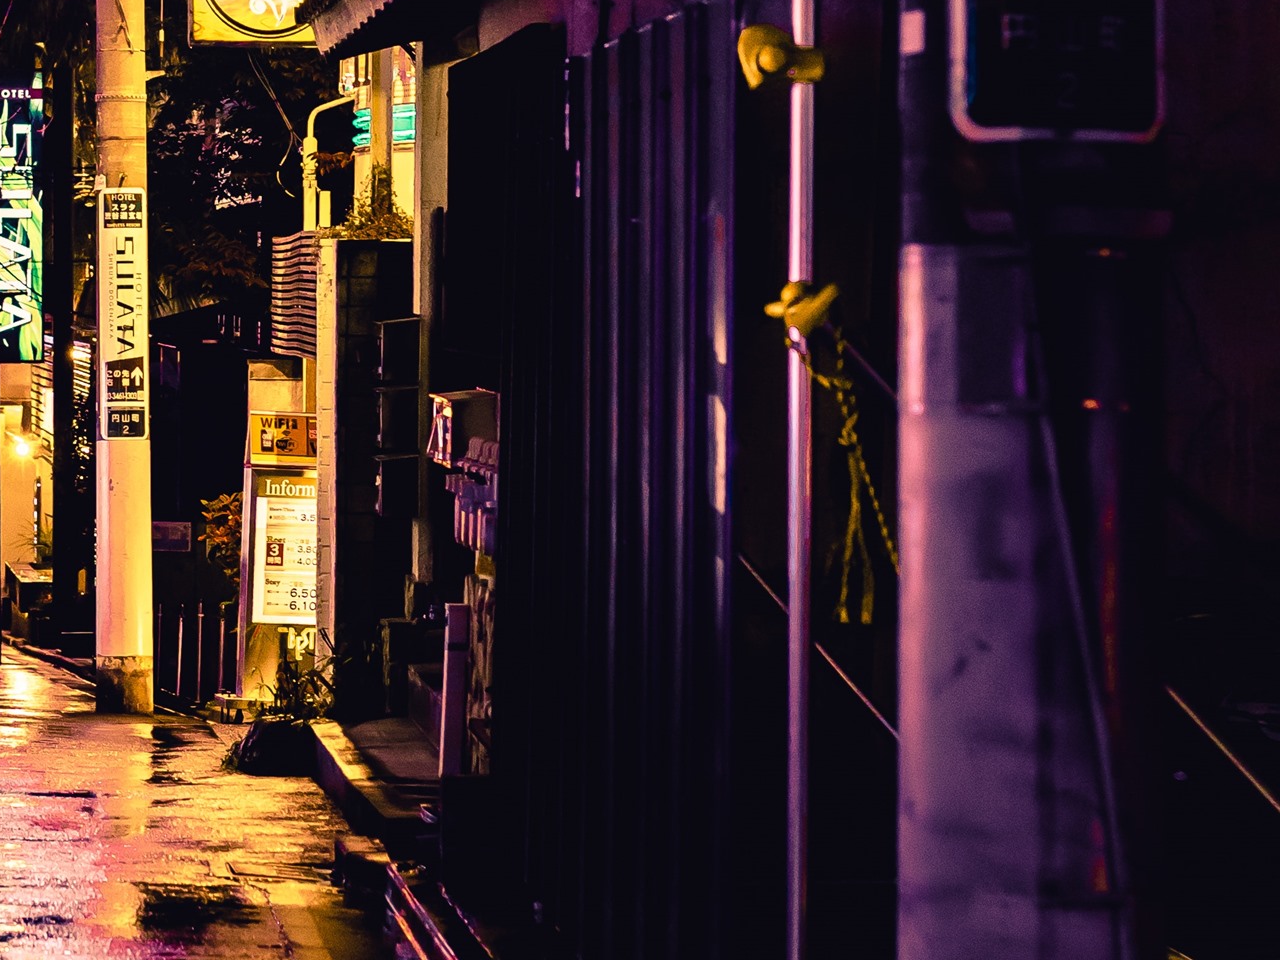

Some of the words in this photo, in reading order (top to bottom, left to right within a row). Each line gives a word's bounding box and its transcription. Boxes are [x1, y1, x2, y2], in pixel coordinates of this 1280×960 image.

[111, 203, 136, 211] スラタ
[116, 237, 134, 355] SULATA
[135, 272, 143, 319] HOTEL
[122, 425, 130, 434] 2
